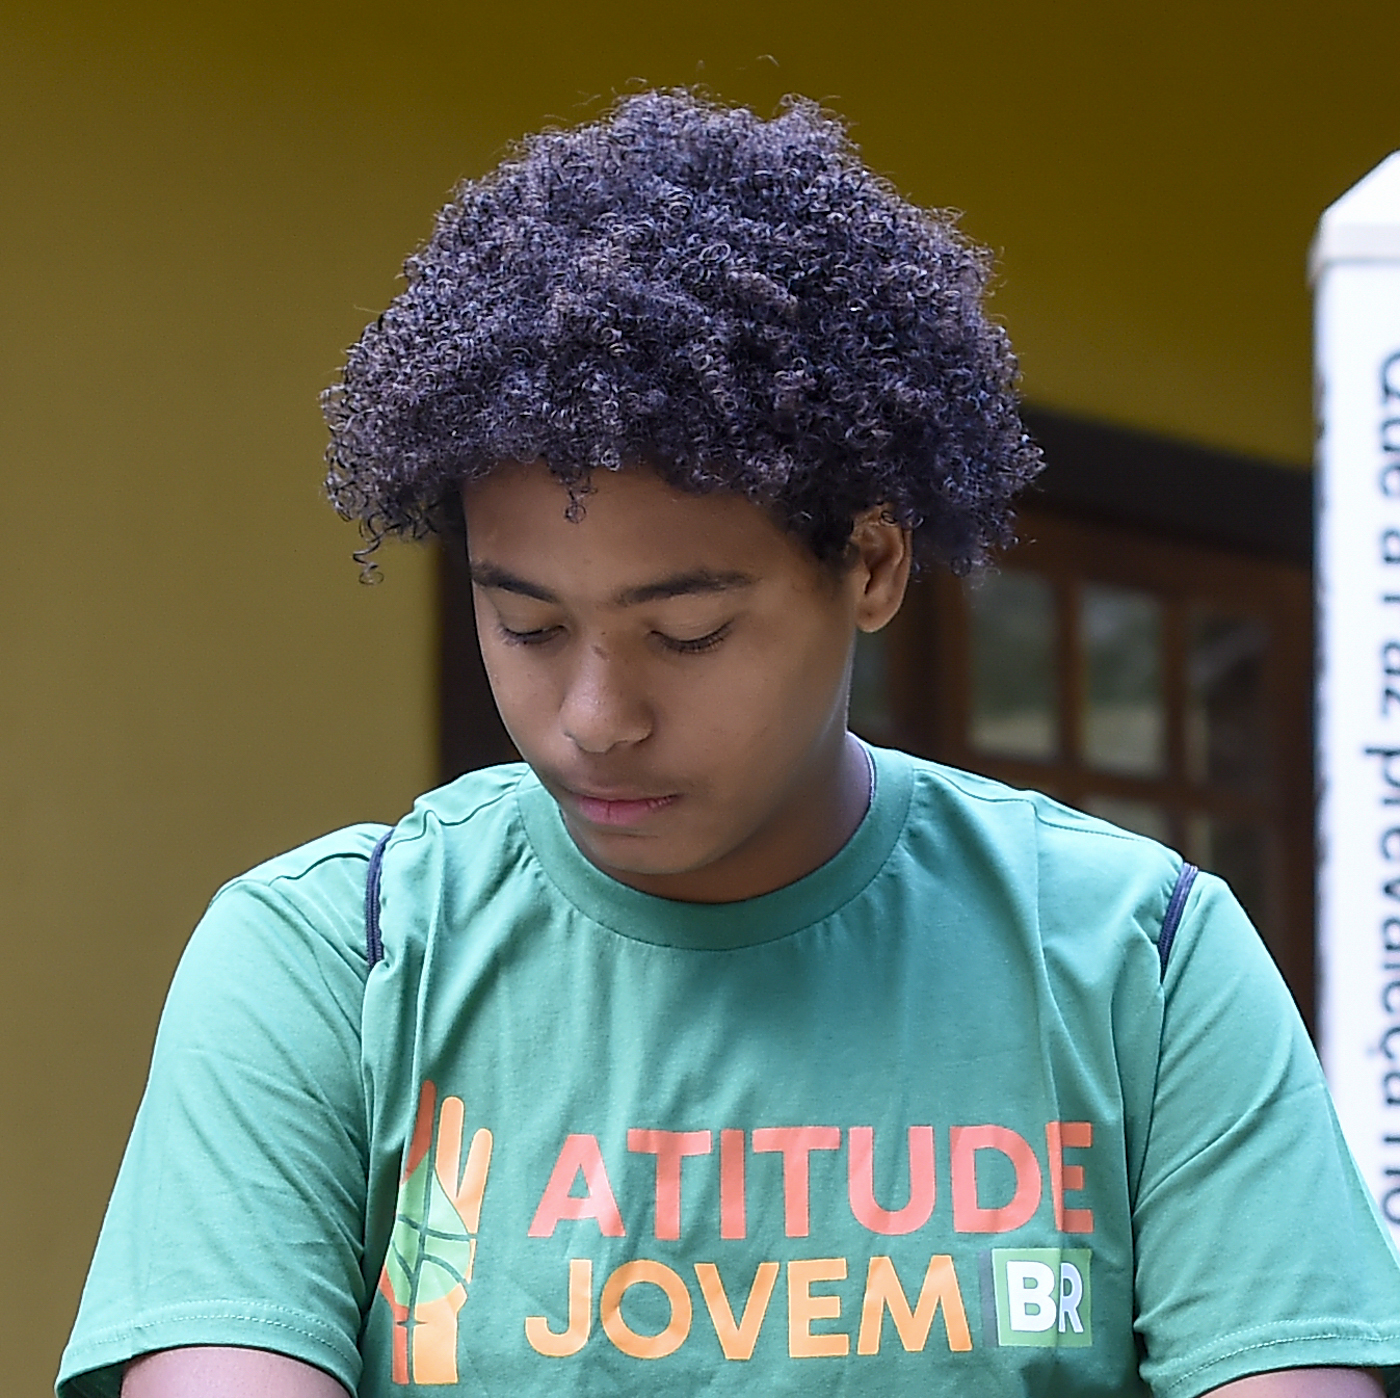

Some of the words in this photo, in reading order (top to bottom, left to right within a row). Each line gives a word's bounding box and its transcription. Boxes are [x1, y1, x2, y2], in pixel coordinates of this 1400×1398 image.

[527, 1120, 1096, 1241] ATITUDE
[524, 1255, 974, 1361] JOVEM
[1005, 1260, 1085, 1336] BR
